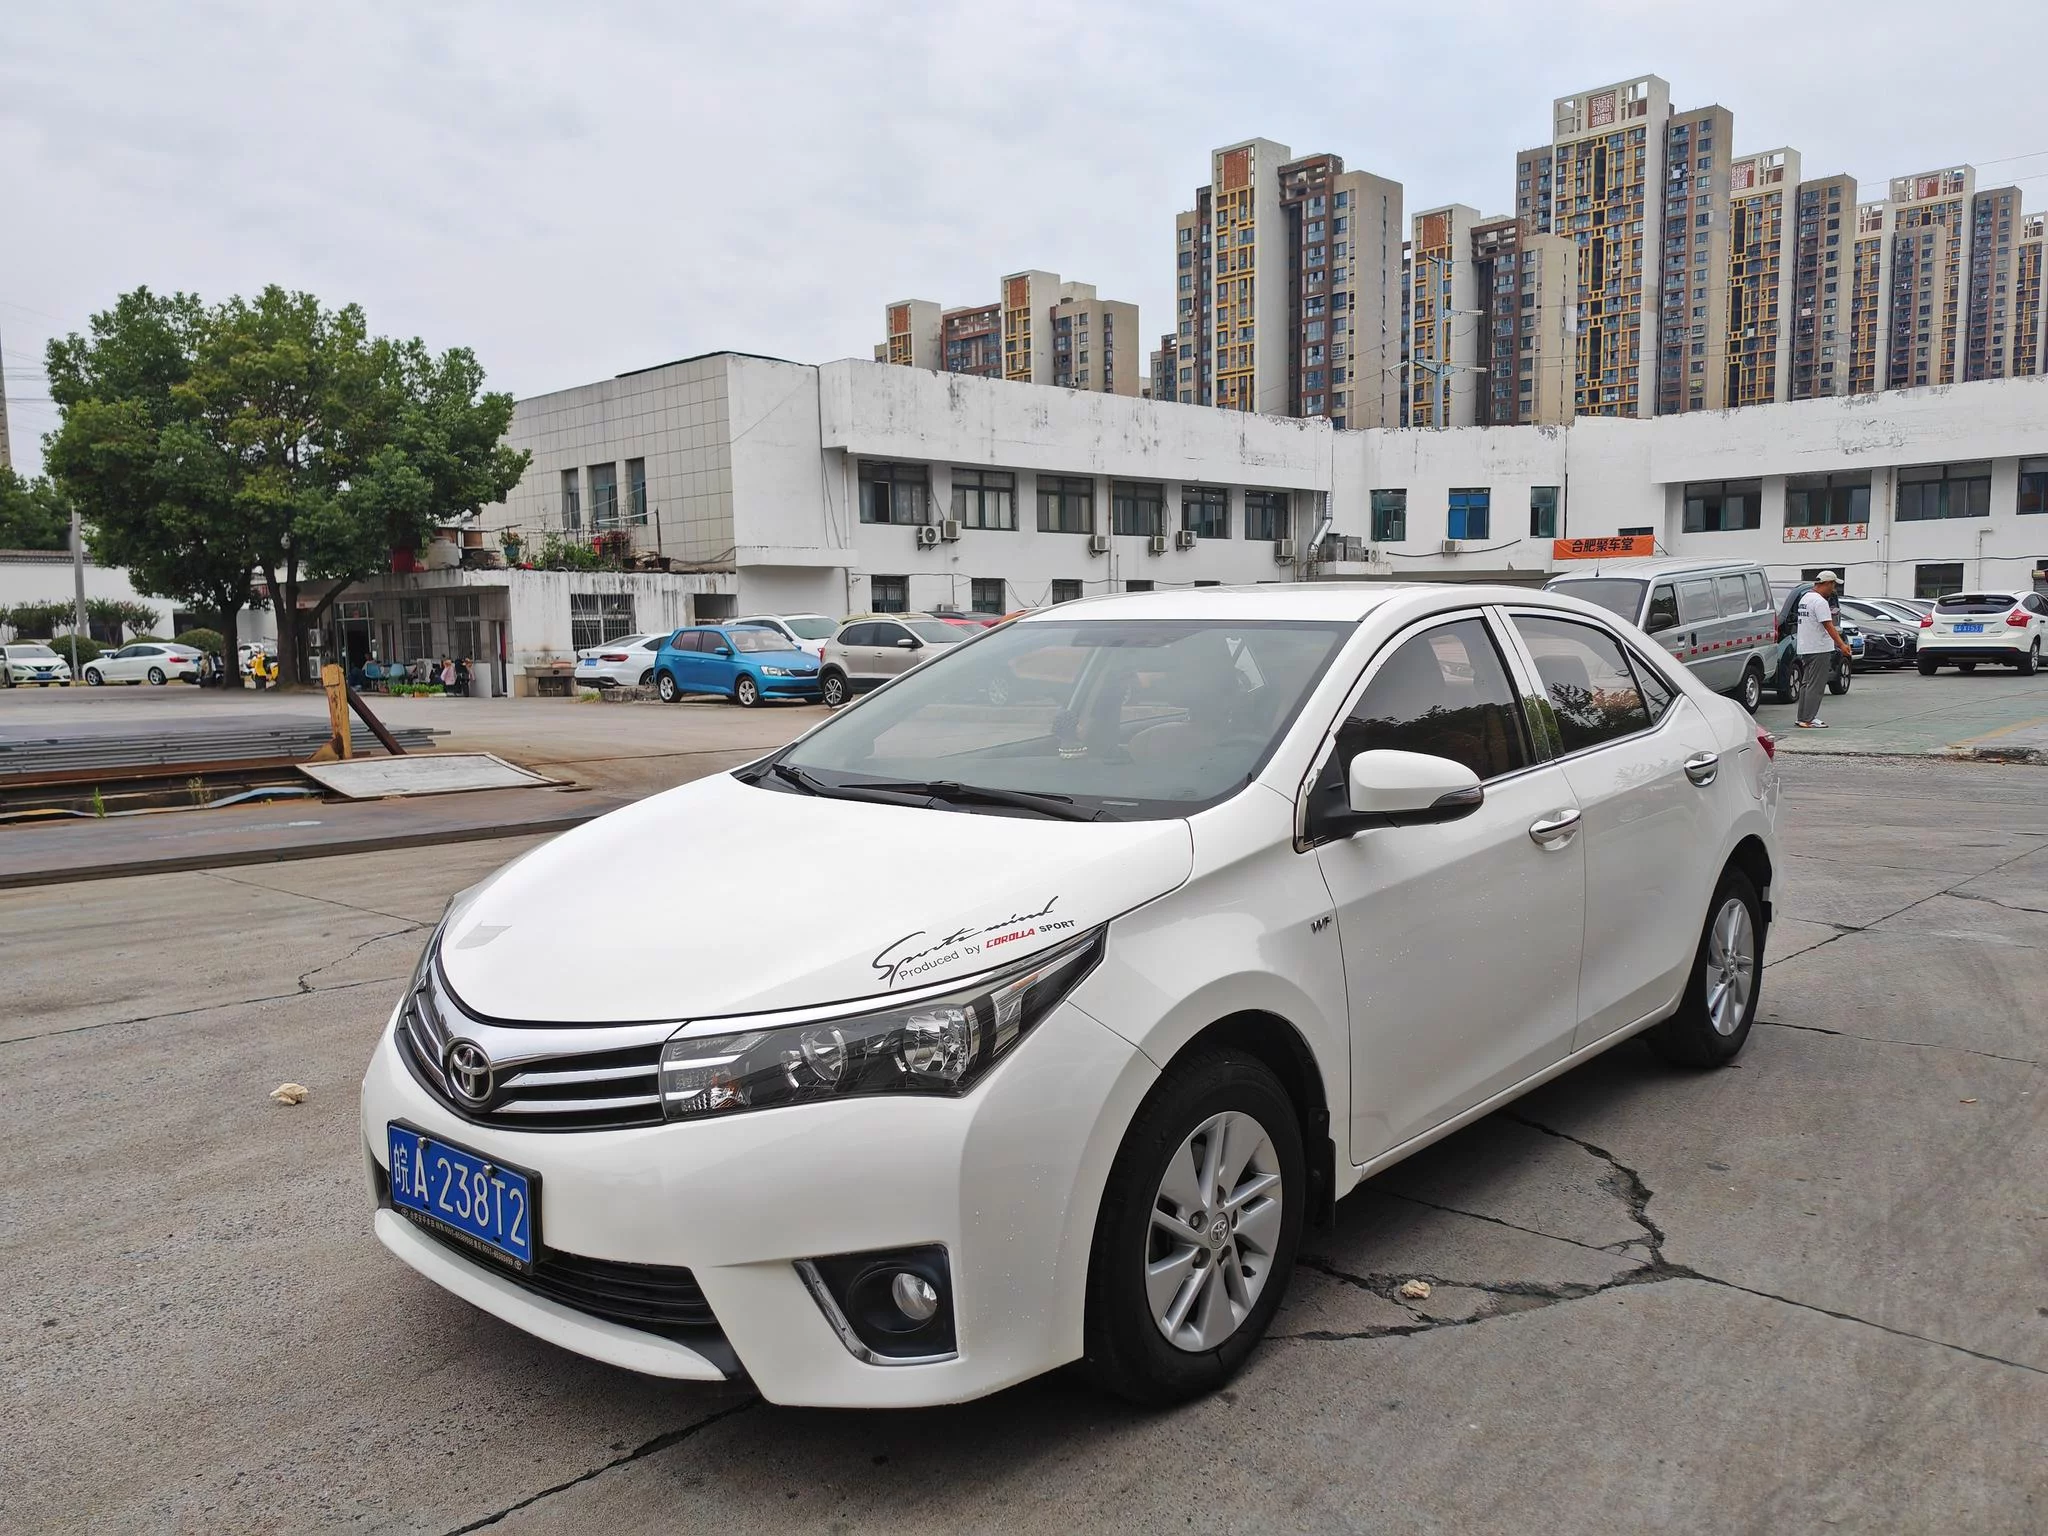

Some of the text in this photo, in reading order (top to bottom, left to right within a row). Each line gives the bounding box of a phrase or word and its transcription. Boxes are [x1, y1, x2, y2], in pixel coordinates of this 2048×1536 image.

[1572, 537, 1634, 553] 合肥聚车堂
[899, 920, 1076, 980] Produced by COROLLA SPORT
